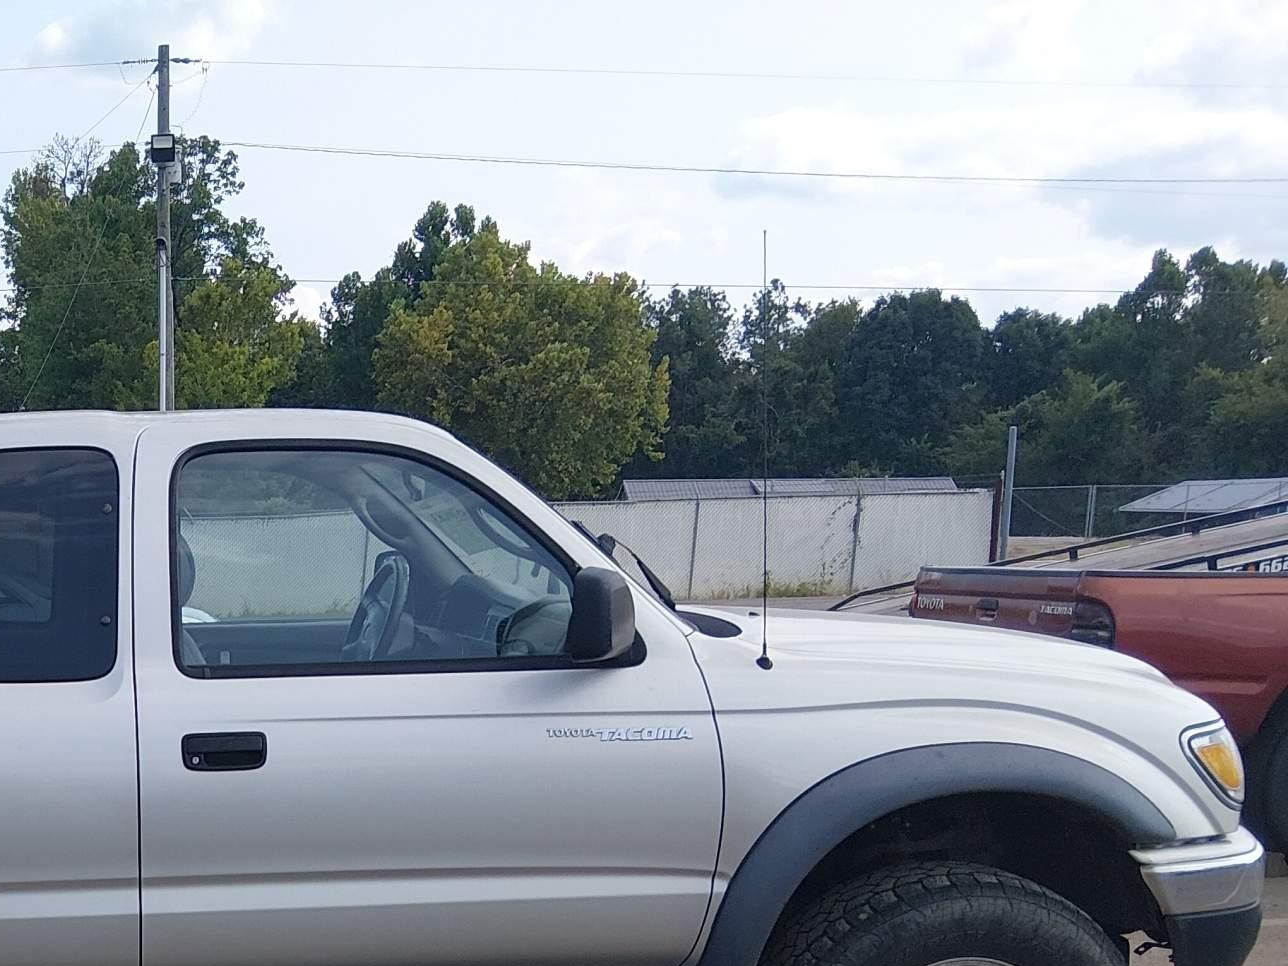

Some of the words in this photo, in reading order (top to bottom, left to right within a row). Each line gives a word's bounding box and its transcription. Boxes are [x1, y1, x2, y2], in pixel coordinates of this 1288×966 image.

[916, 597, 944, 610] TOYOTA
[1039, 605, 1073, 615] TACOMA
[546, 728, 596, 738] TOYOTA
[596, 727, 693, 741] TACOMA
